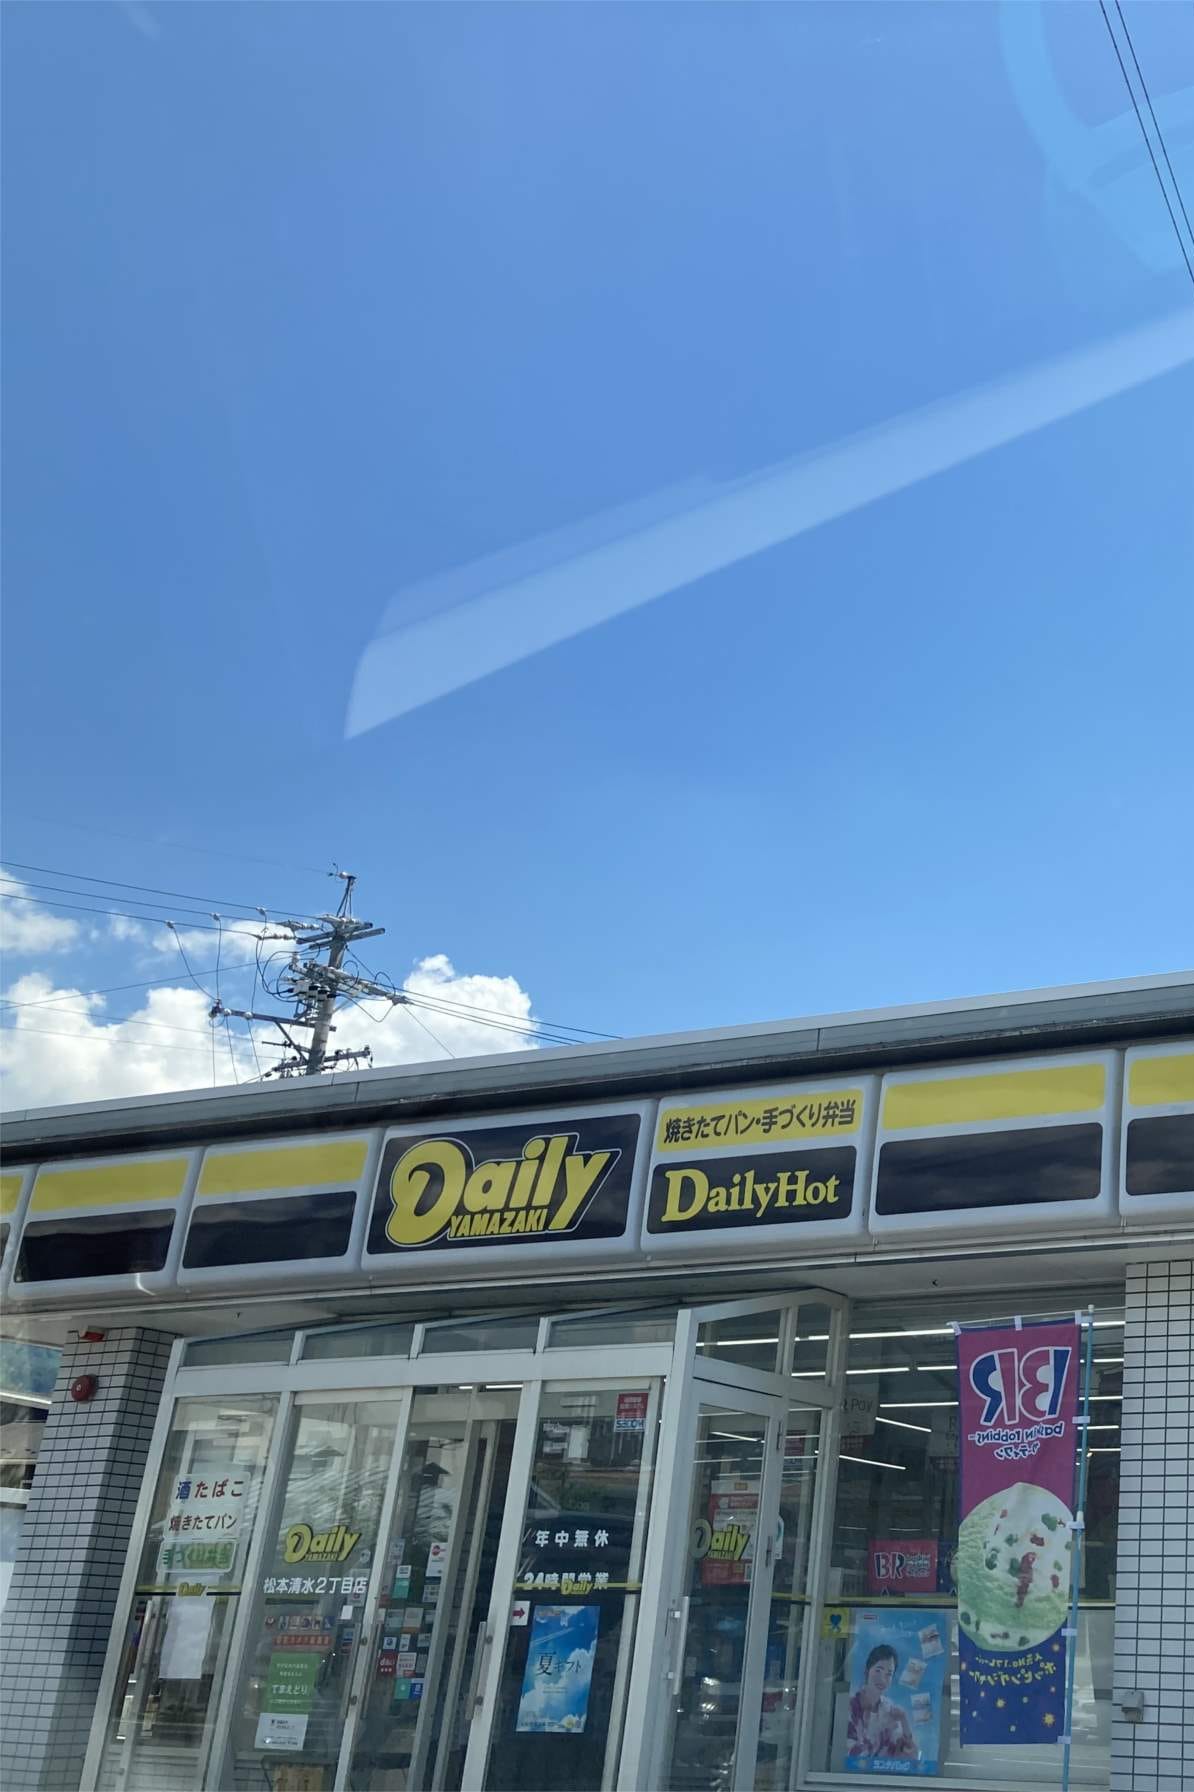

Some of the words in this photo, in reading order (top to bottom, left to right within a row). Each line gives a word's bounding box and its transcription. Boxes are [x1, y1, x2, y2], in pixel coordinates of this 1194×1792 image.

[663, 1100, 857, 1144] 焼きたてパン・手づくり弁当
[387, 1133, 619, 1245] Daily
[661, 1168, 841, 1222] DailyHot
[448, 1209, 549, 1239] YAMAZAKI
[176, 1480, 192, 1500] 酒
[194, 1477, 245, 1498] たばこ
[168, 1513, 239, 1532] 焼きたてパン
[283, 1523, 362, 1563] Daily
[534, 1529, 610, 1548] 年中無休
[688, 1518, 751, 1560] Daily
[874, 1552, 905, 1579] BR
[263, 1576, 369, 1595] 松本清水2丁目店
[561, 1578, 594, 1596] Daily
